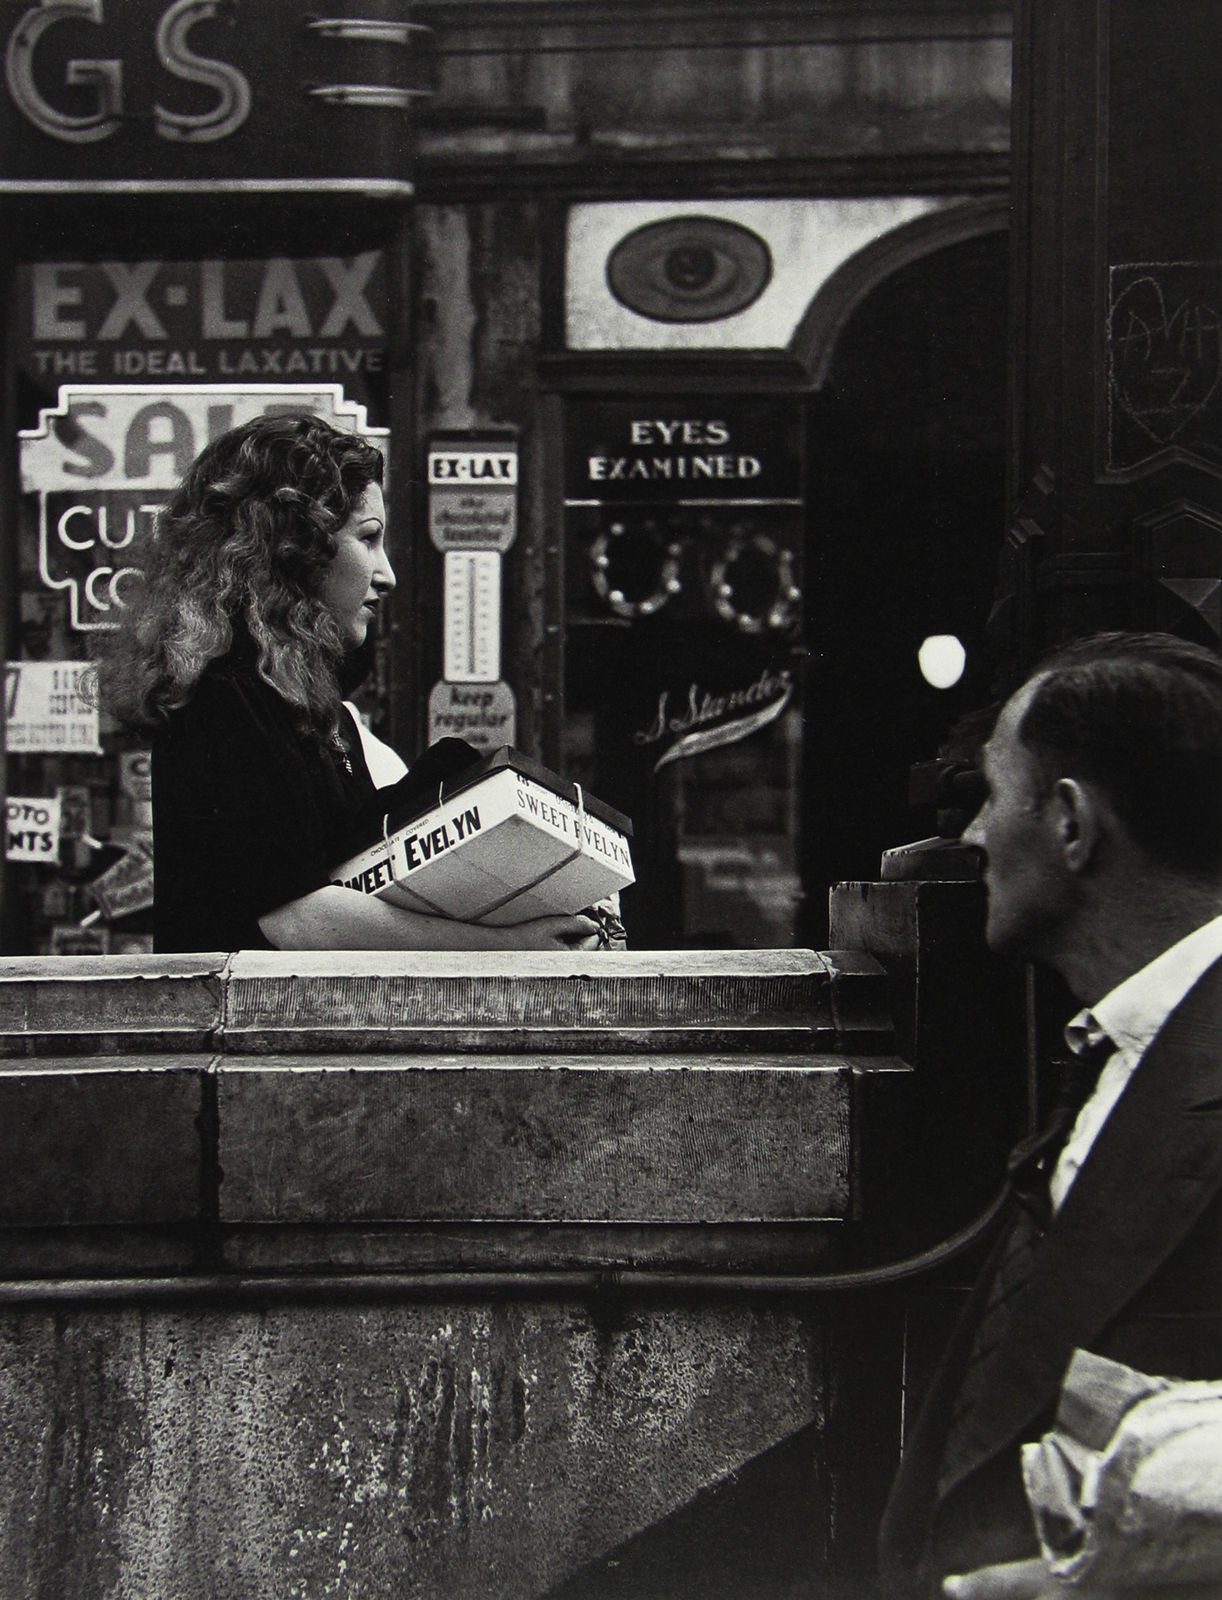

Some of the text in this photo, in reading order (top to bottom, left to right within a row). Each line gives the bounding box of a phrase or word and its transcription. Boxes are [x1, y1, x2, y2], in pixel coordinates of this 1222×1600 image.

[5, 0, 252, 143] GS
[35, 347, 384, 375] THE IDEAL LAXATIVE
[630, 420, 731, 446] EYES
[588, 455, 763, 481] EXAMINED
[57, 505, 171, 550] CUT
[403, 805, 482, 872] EVELYN
[516, 788, 569, 833] SWEET
[574, 819, 631, 868] EVELYN
